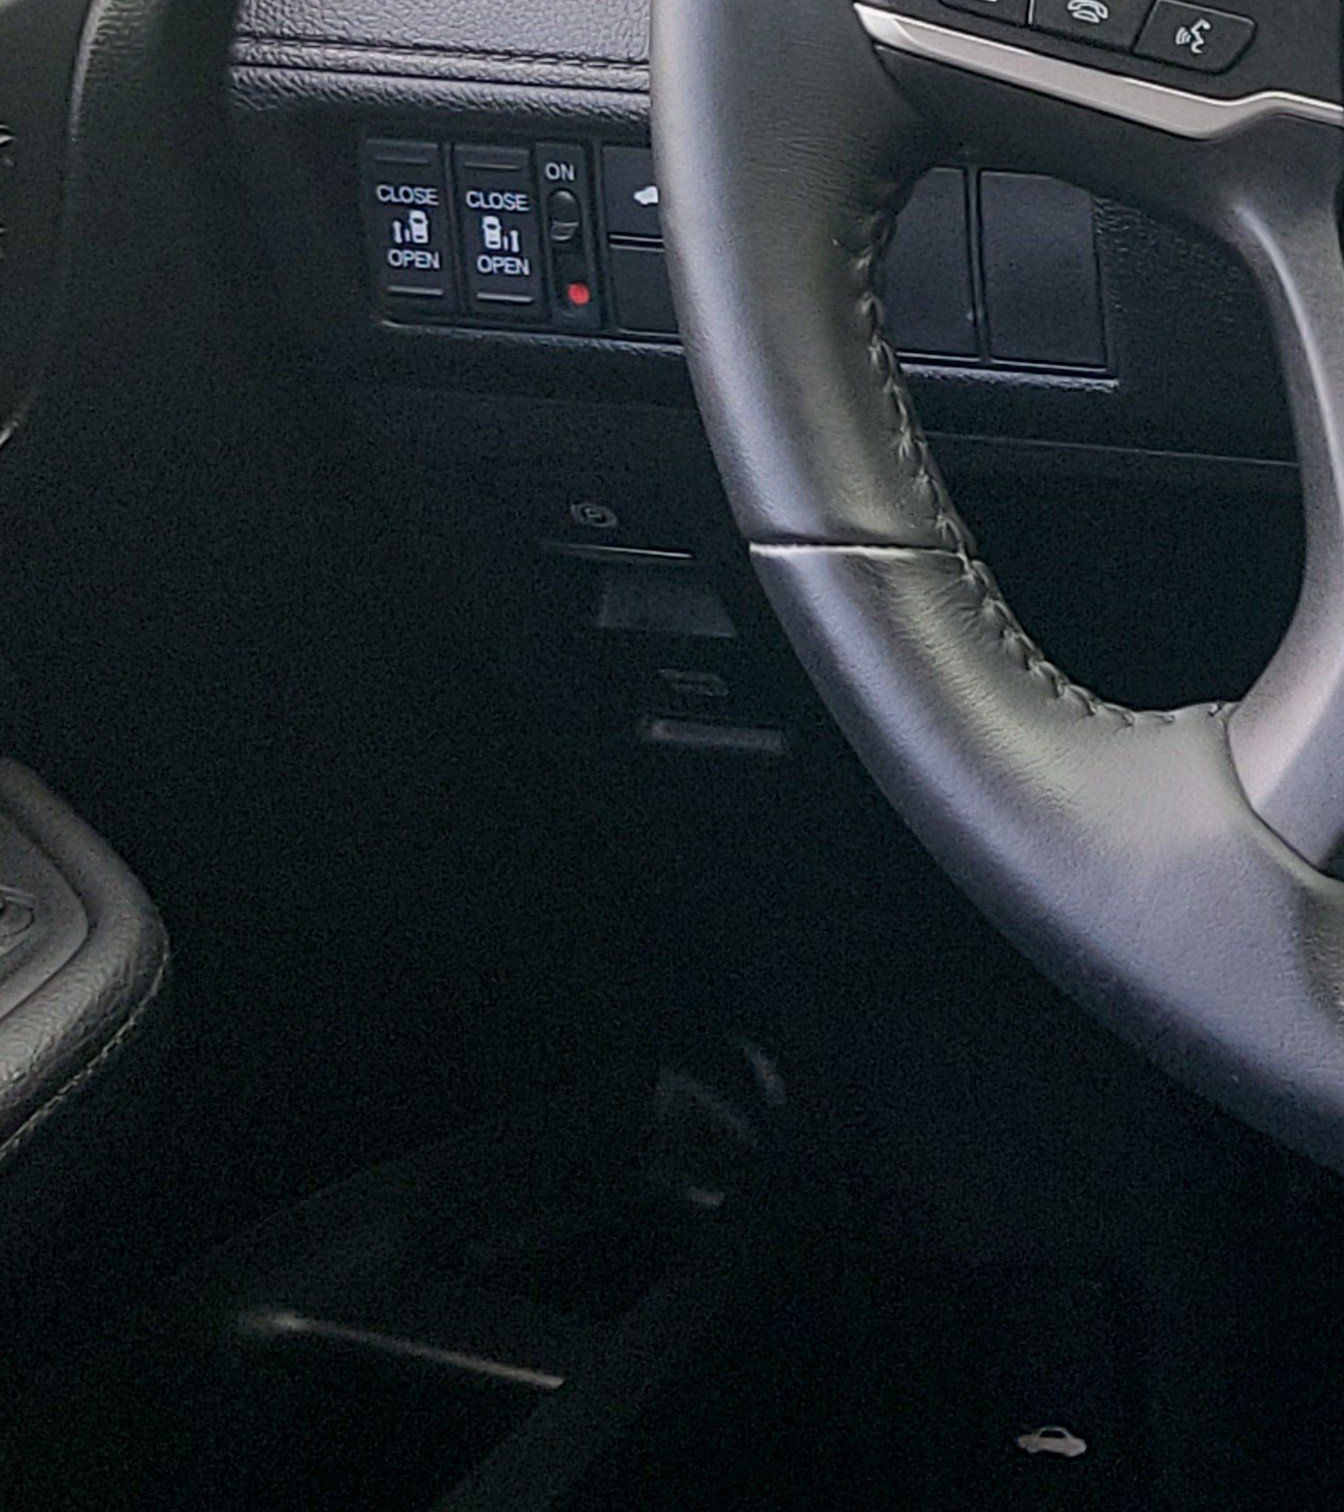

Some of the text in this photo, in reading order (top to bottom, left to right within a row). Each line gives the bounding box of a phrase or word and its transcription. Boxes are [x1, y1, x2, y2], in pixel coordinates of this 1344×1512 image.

[546, 162, 575, 181] ON
[376, 184, 440, 207] CLOSE
[466, 190, 531, 212] CLOSE
[388, 248, 441, 270] OPEN
[477, 253, 531, 276] OPEN
